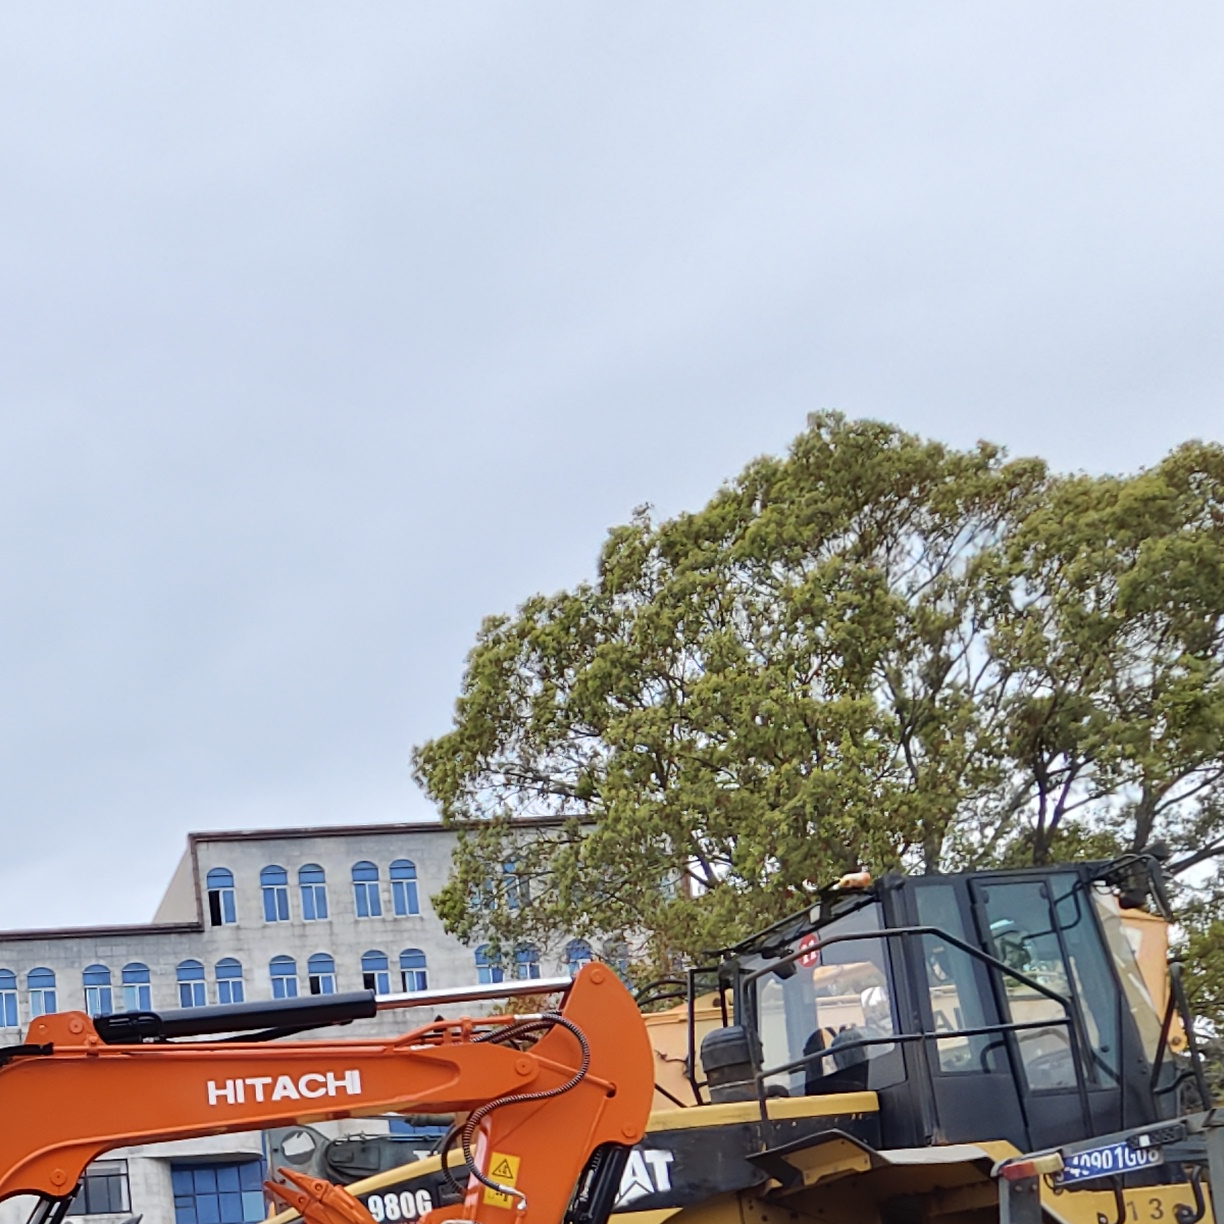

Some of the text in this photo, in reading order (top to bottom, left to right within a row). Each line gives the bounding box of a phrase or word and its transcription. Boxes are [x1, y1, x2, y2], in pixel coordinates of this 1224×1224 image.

[207, 1070, 361, 1105] HITACHI
[614, 1148, 674, 1207] AT
[367, 1188, 433, 1223] 980G
